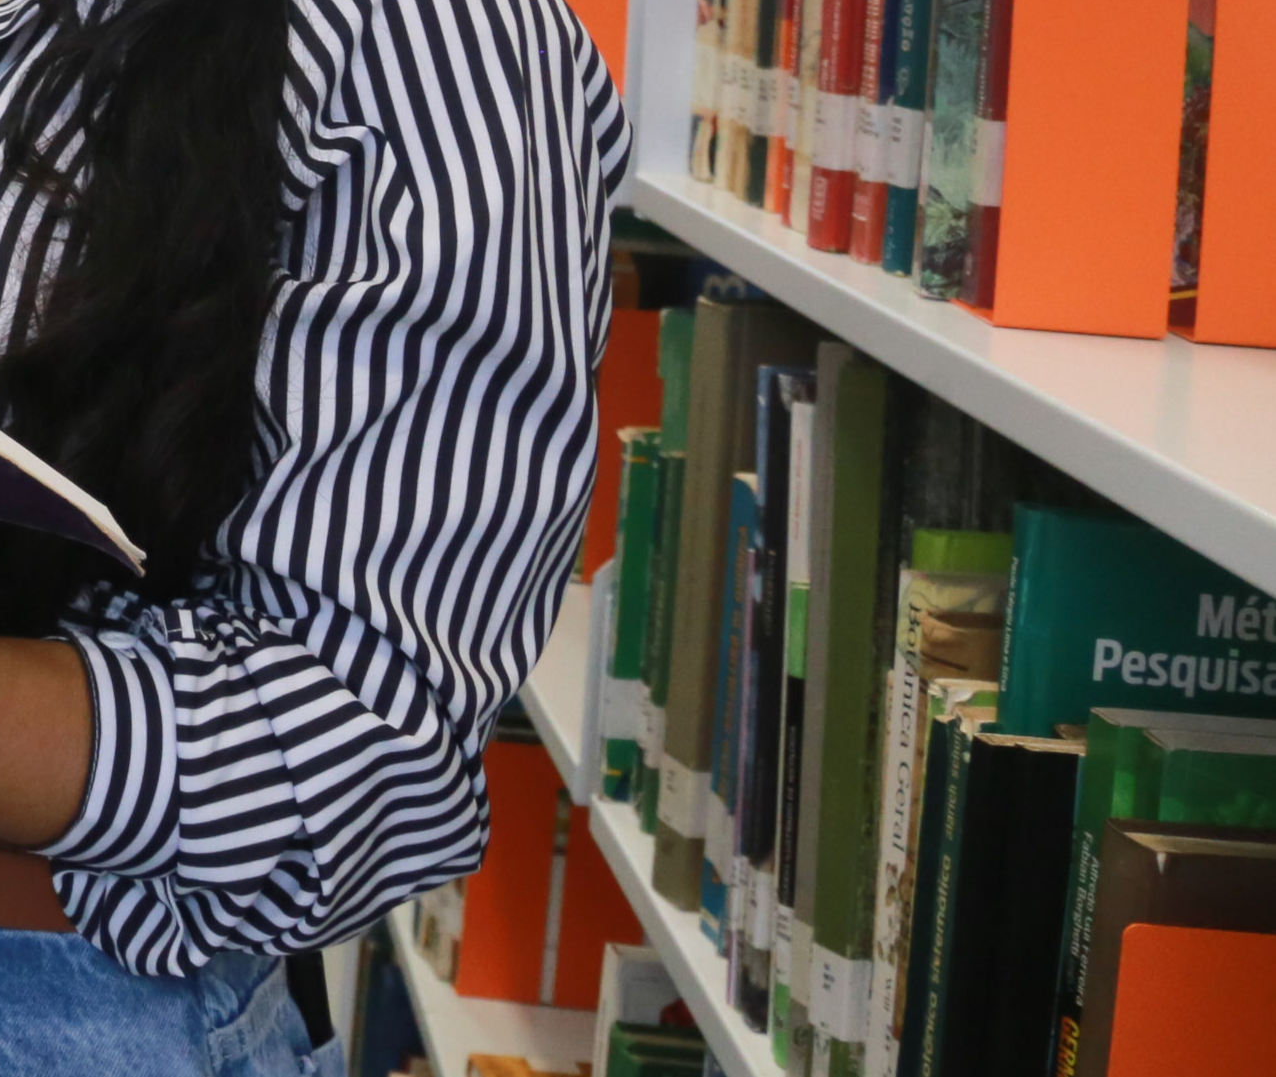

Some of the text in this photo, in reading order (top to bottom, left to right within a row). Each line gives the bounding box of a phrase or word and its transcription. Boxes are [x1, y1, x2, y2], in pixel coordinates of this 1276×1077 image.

[1009, 556, 1020, 590] Paulo
[1005, 591, 1017, 626] Sérgio
[1196, 592, 1276, 644] Mét
[1003, 626, 1014, 655] Lima
[1092, 637, 1276, 699] Pesquisa
[999, 665, 1010, 693] Silva
[891, 601, 924, 853] Botânica Geral
[1069, 830, 1094, 958] Fabian Borghetti
[1086, 856, 1101, 913] Alfredo
[929, 853, 952, 984] sistemática
[1074, 943, 1091, 1008] Ferreira
